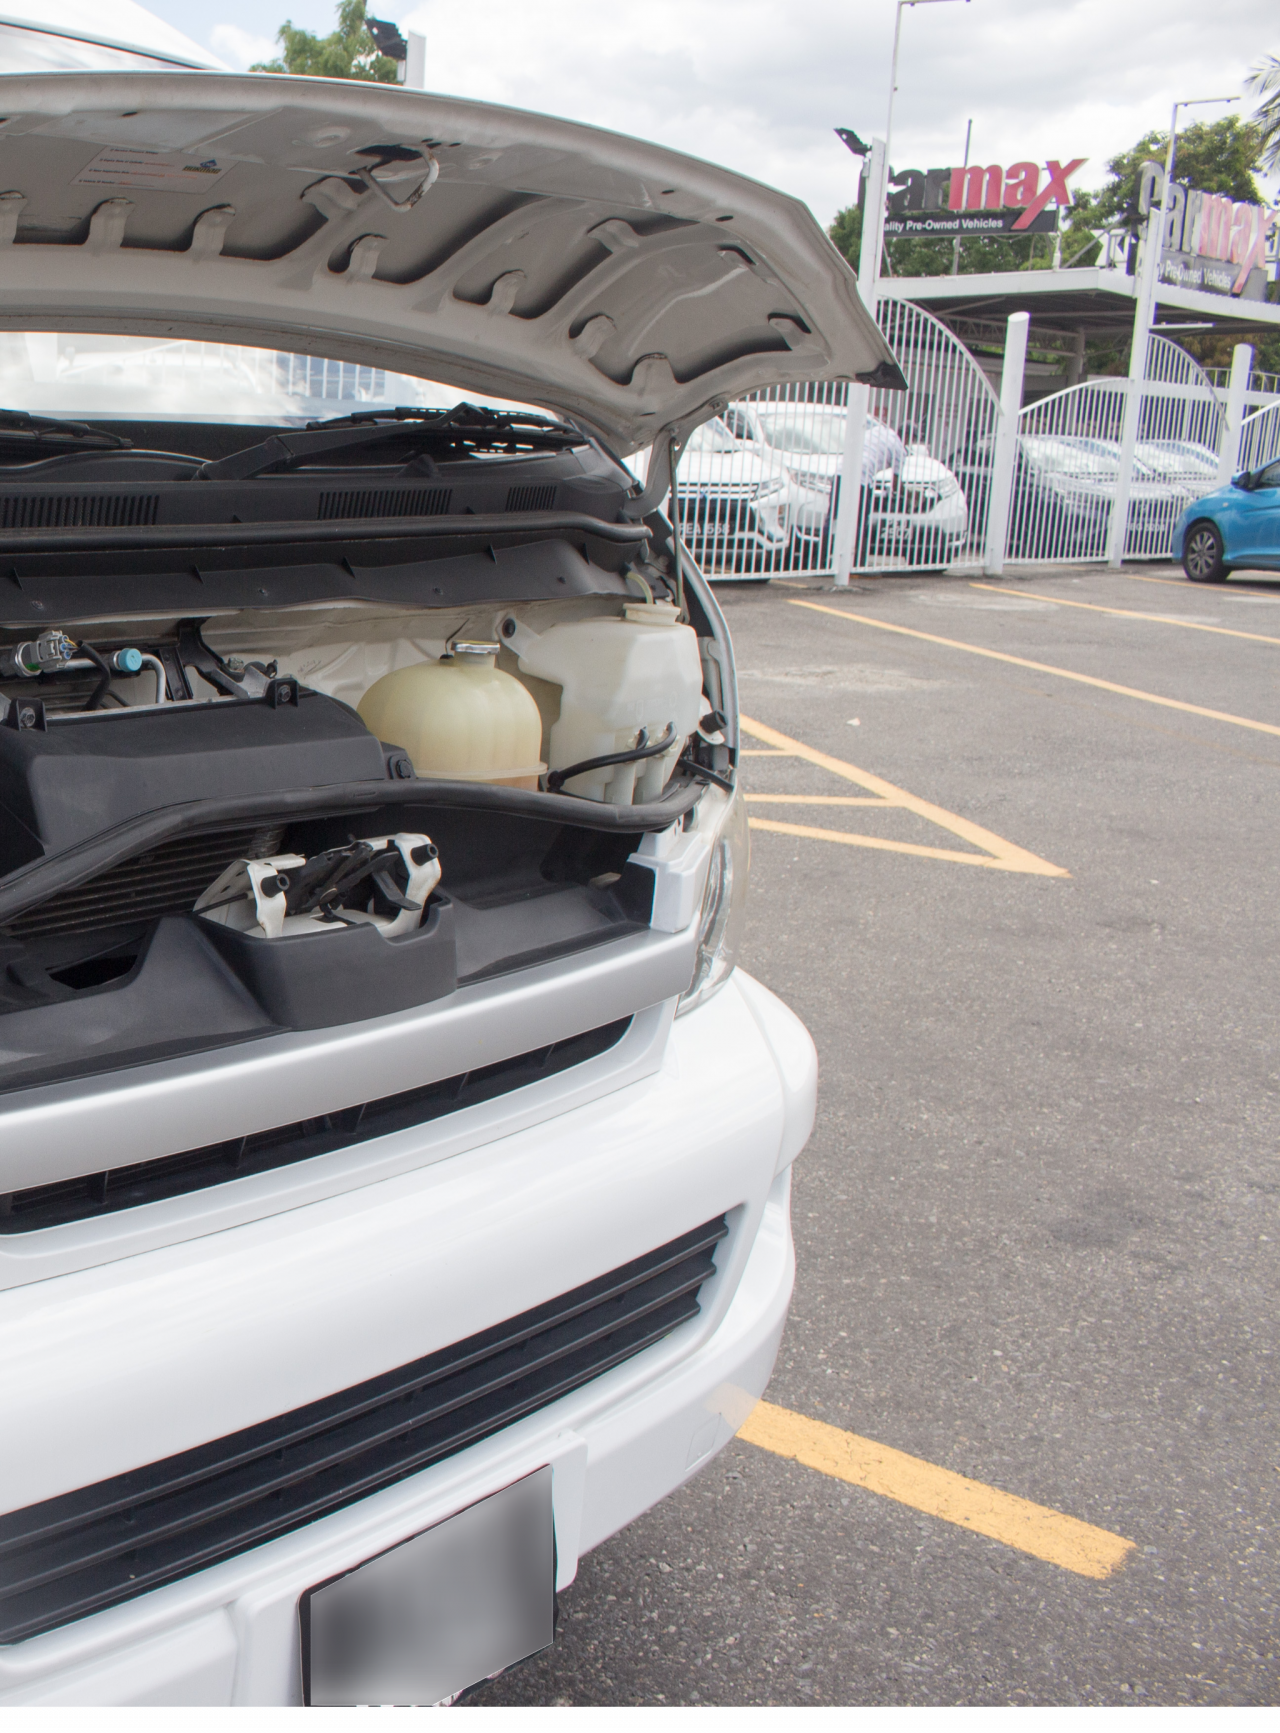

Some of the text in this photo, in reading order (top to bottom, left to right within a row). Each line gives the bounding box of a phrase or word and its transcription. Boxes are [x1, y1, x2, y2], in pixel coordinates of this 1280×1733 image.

[884, 218, 1003, 233] ality Pre-Owned Vehicles
